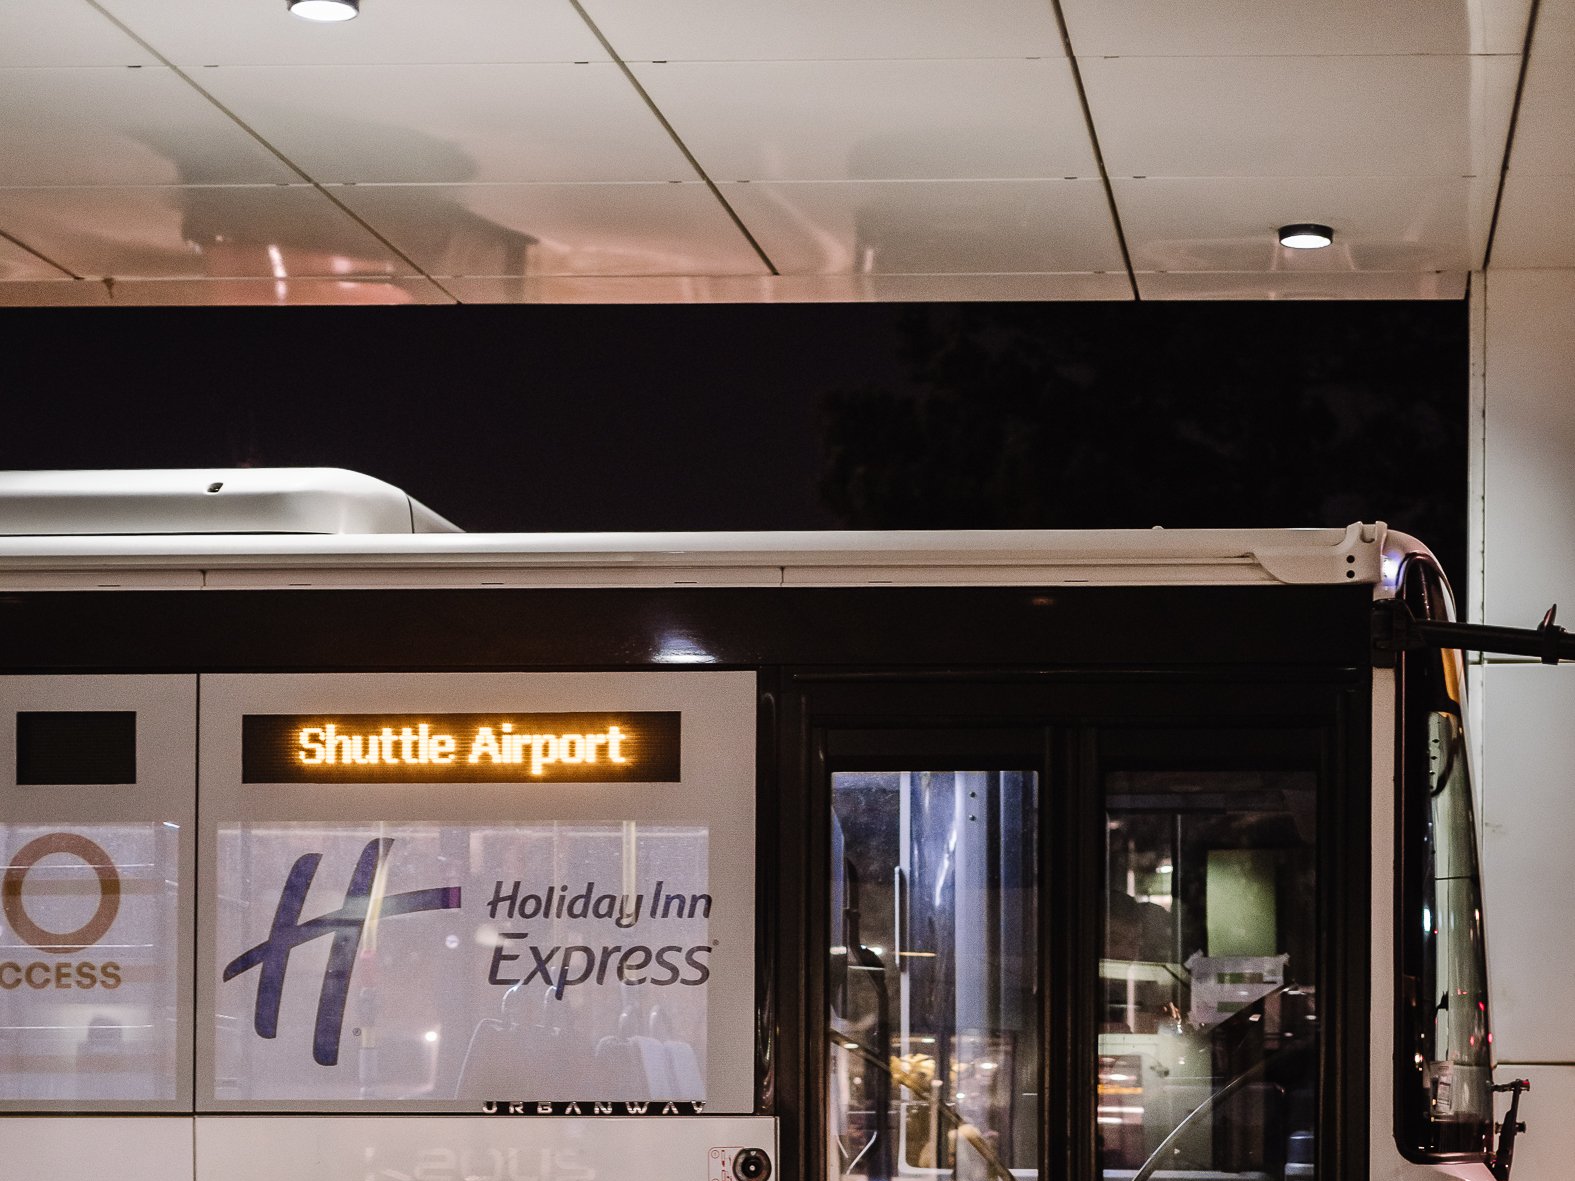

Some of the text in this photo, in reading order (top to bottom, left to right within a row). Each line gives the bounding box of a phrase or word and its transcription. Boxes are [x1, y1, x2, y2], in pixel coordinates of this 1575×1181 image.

[298, 722, 627, 776] Shuttle Airport
[486, 880, 712, 929] Holiday Inn
[488, 932, 713, 1001] Express
